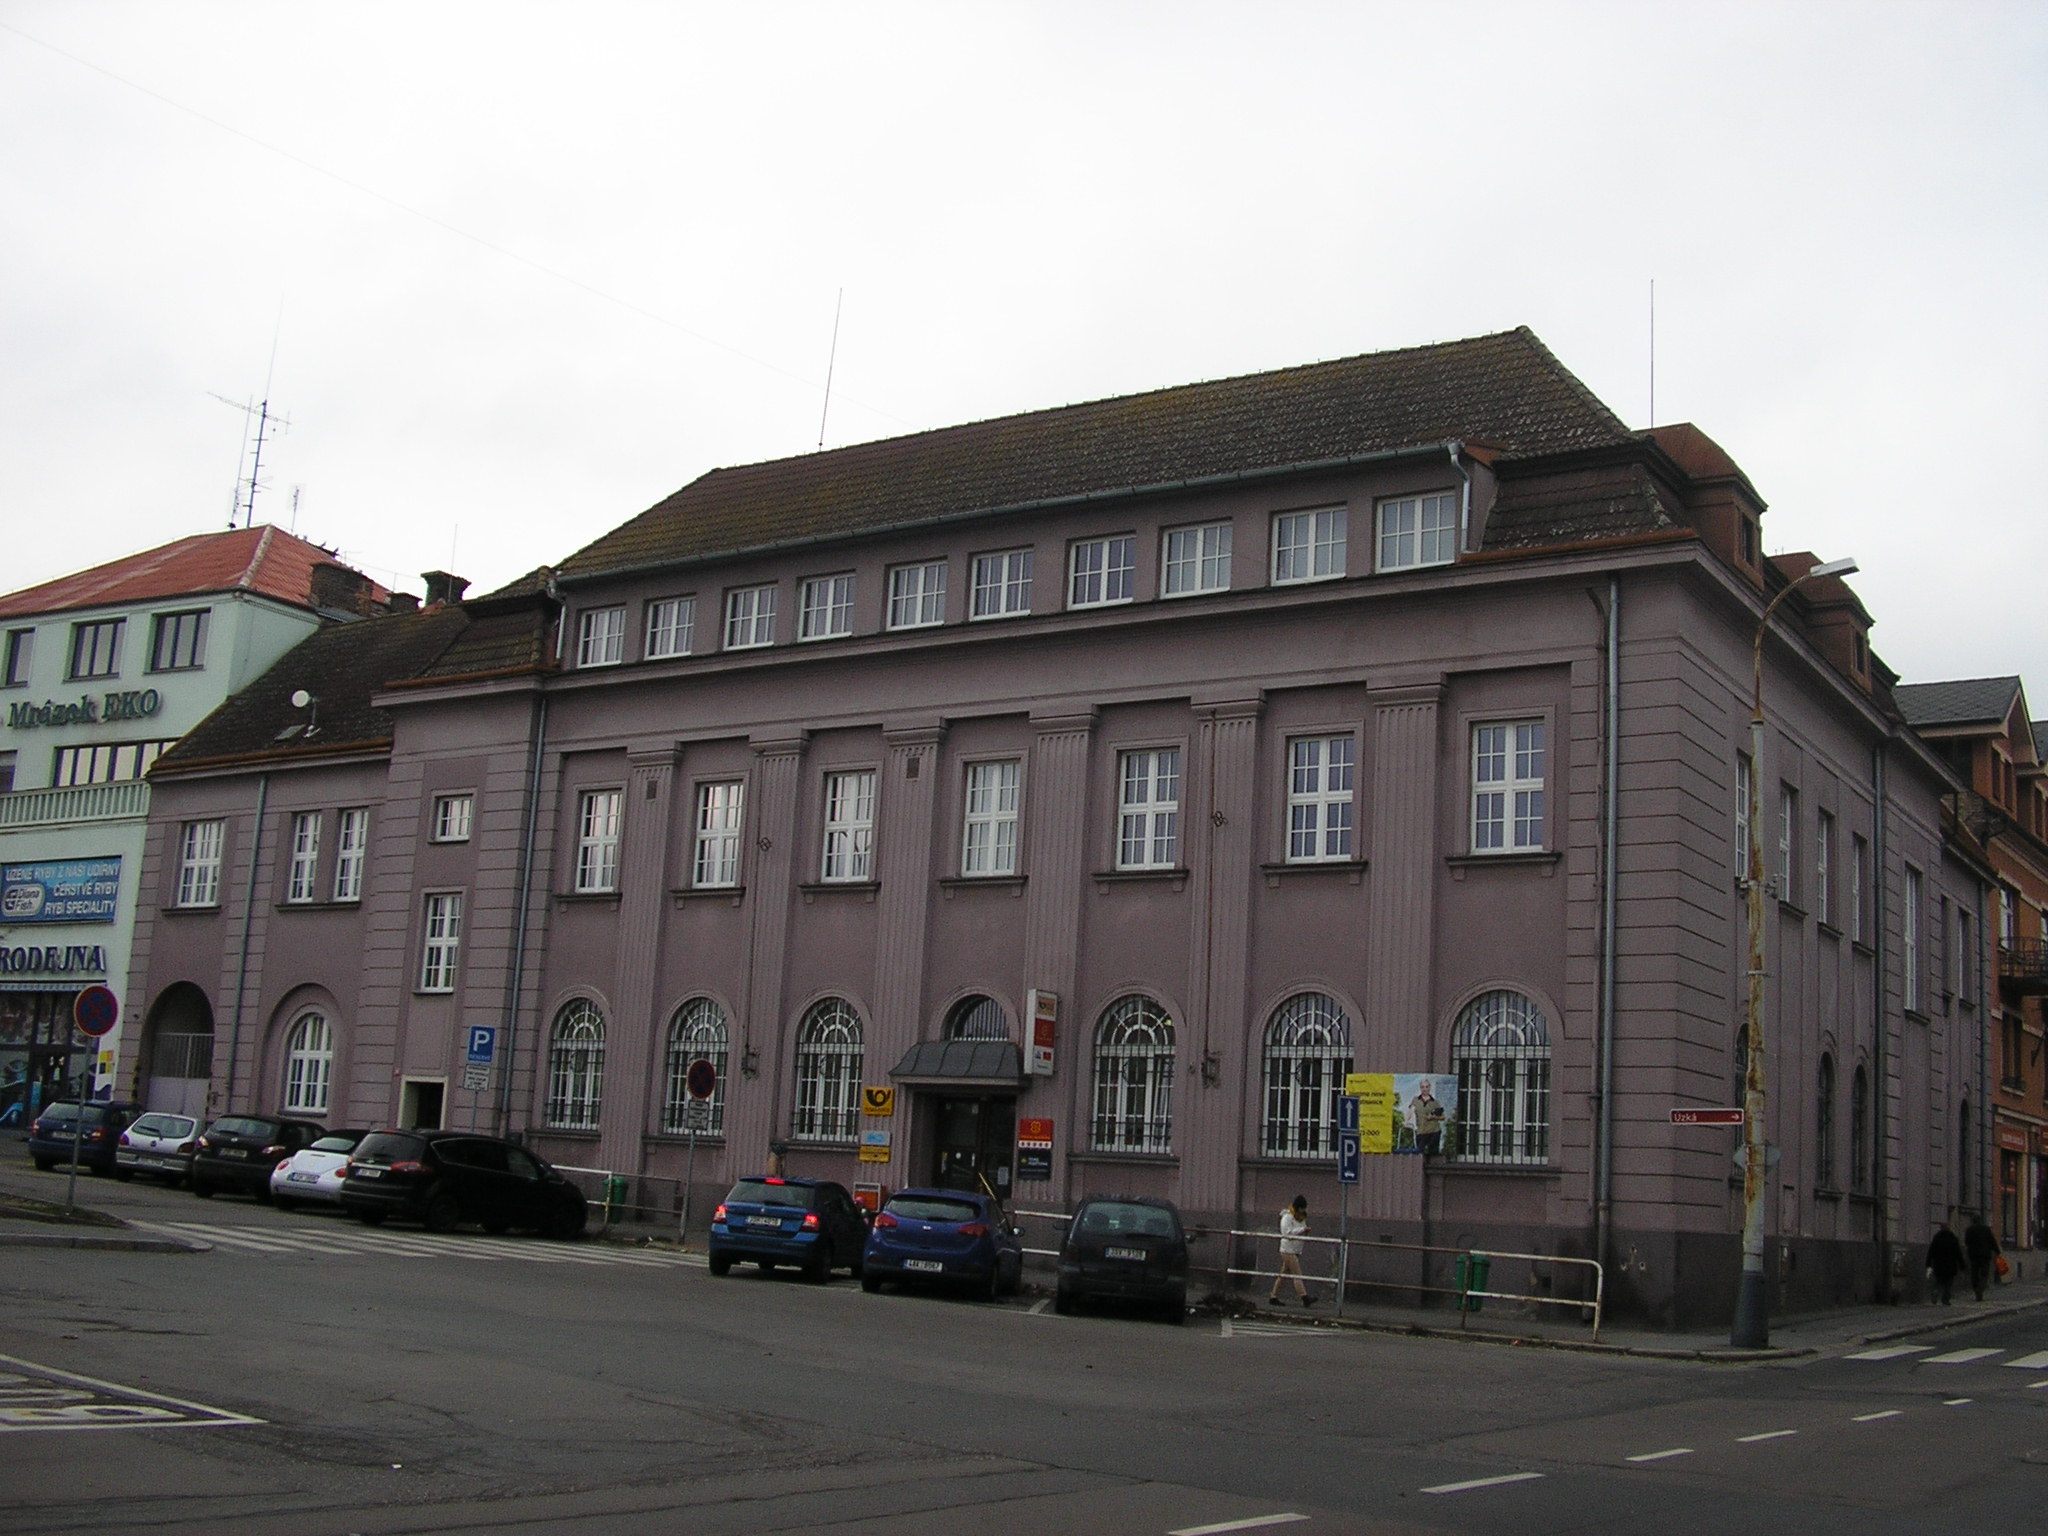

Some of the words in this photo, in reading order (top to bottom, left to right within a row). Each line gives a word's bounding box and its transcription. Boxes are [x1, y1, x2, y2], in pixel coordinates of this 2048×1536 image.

[102, 689, 161, 720] EKO
[94, 881, 118, 895] RYBY
[66, 899, 116, 914] SPECIALITY
[473, 1030, 490, 1052] P
[1344, 1139, 1356, 1167] P
